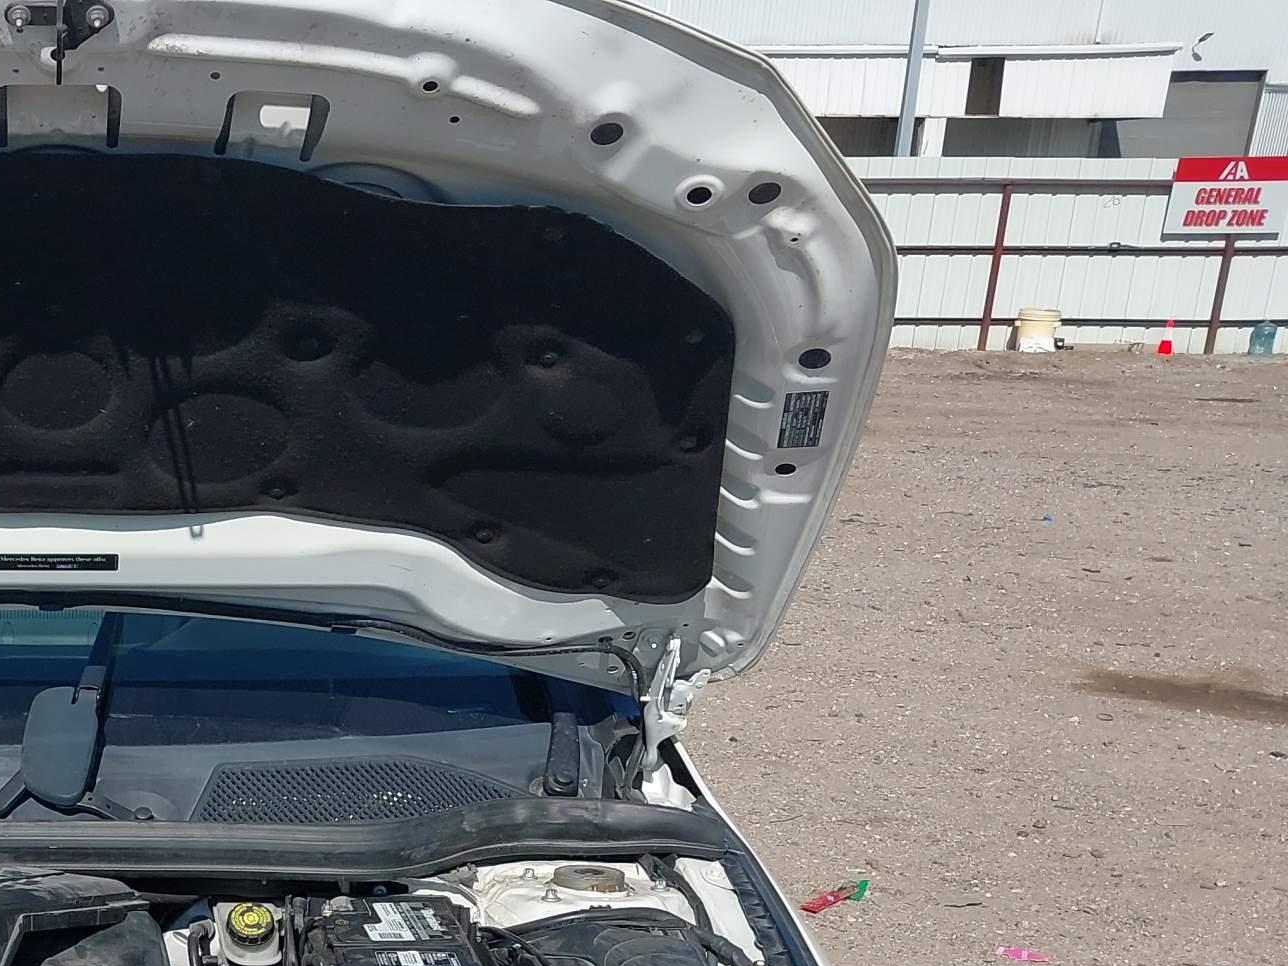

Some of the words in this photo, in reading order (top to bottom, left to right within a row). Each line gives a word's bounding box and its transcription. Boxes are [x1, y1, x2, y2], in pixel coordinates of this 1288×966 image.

[1194, 187, 1261, 205] GENERAL
[1183, 210, 1227, 227] DROP
[1227, 209, 1268, 226] ZONE
